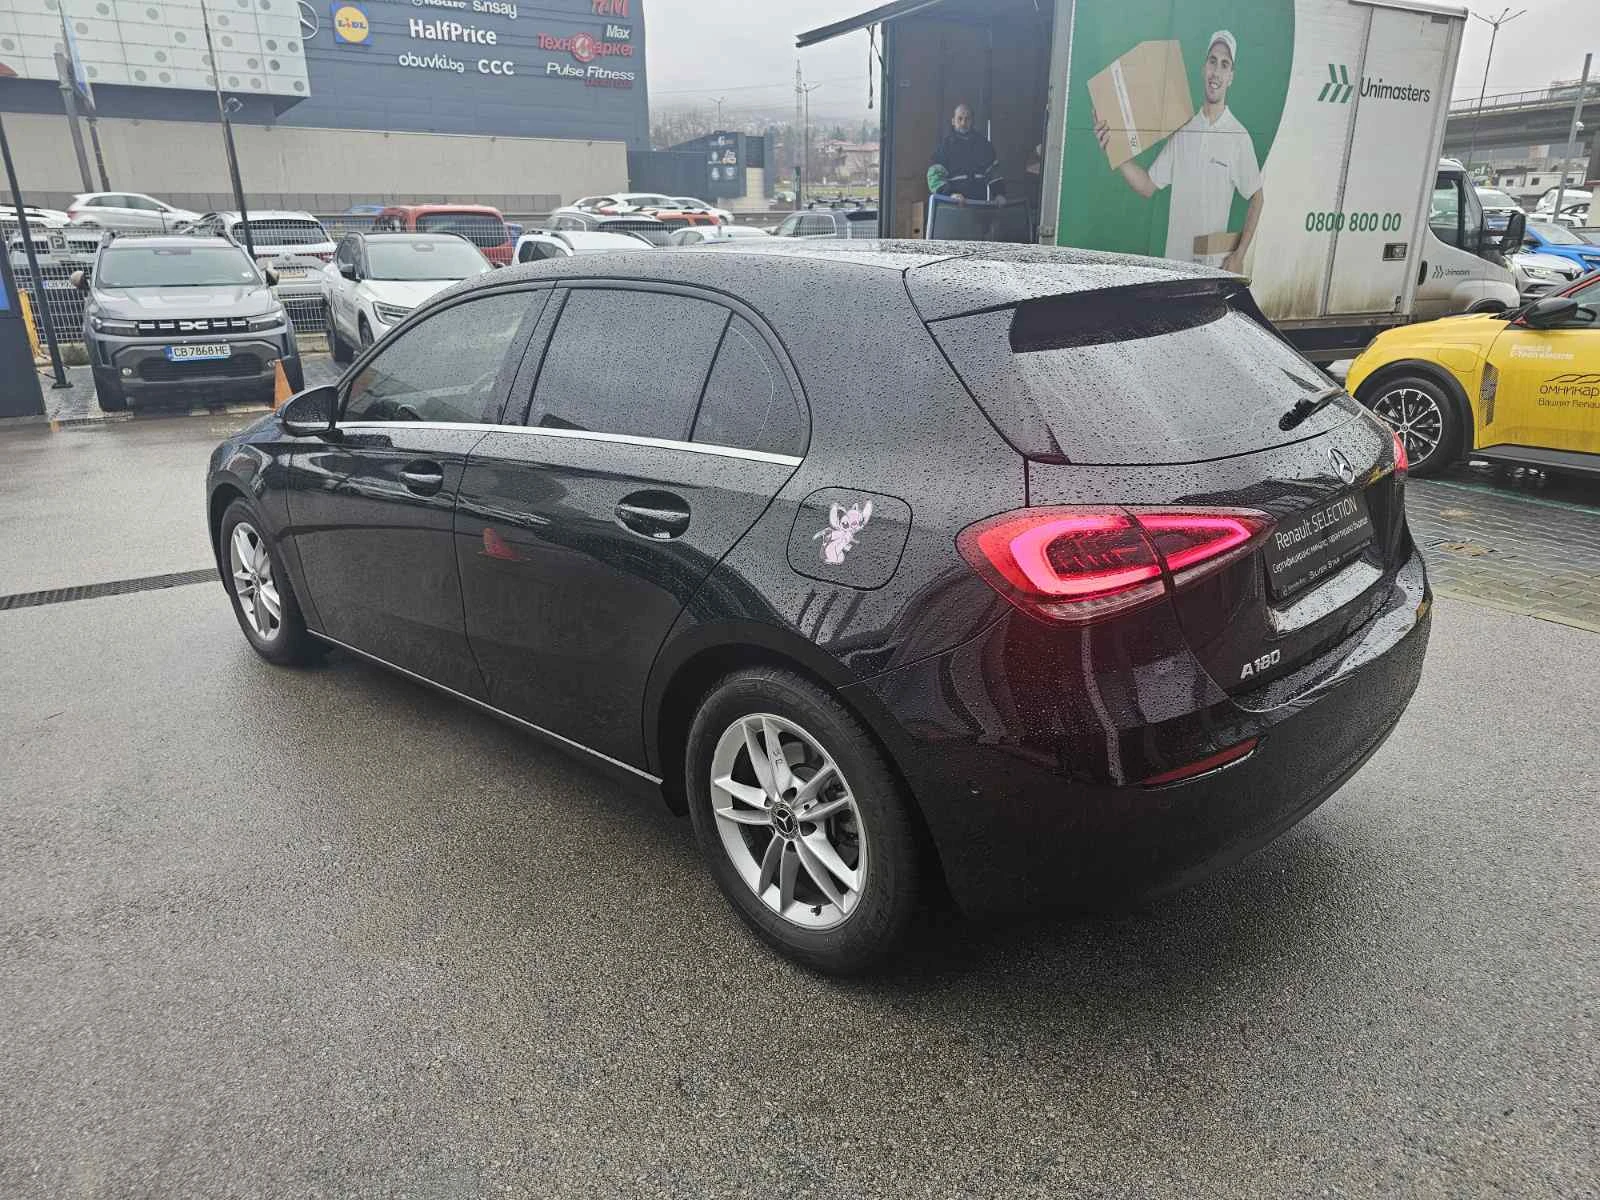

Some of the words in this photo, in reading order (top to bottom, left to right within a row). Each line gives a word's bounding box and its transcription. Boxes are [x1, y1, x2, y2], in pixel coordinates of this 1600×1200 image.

[409, 18, 497, 45] HalfPrice
[606, 24, 631, 39] Max
[398, 52, 465, 73] obuvki.bg
[546, 62, 585, 77] Pulse
[587, 66, 635, 81] Fitness
[1360, 77, 1431, 103] Unimasters
[1305, 212, 1345, 232] 0800
[1348, 212, 1379, 232] 800
[1382, 212, 1402, 232] 00
[1275, 519, 1313, 550] Renault
[1311, 495, 1358, 533] SELECTION
